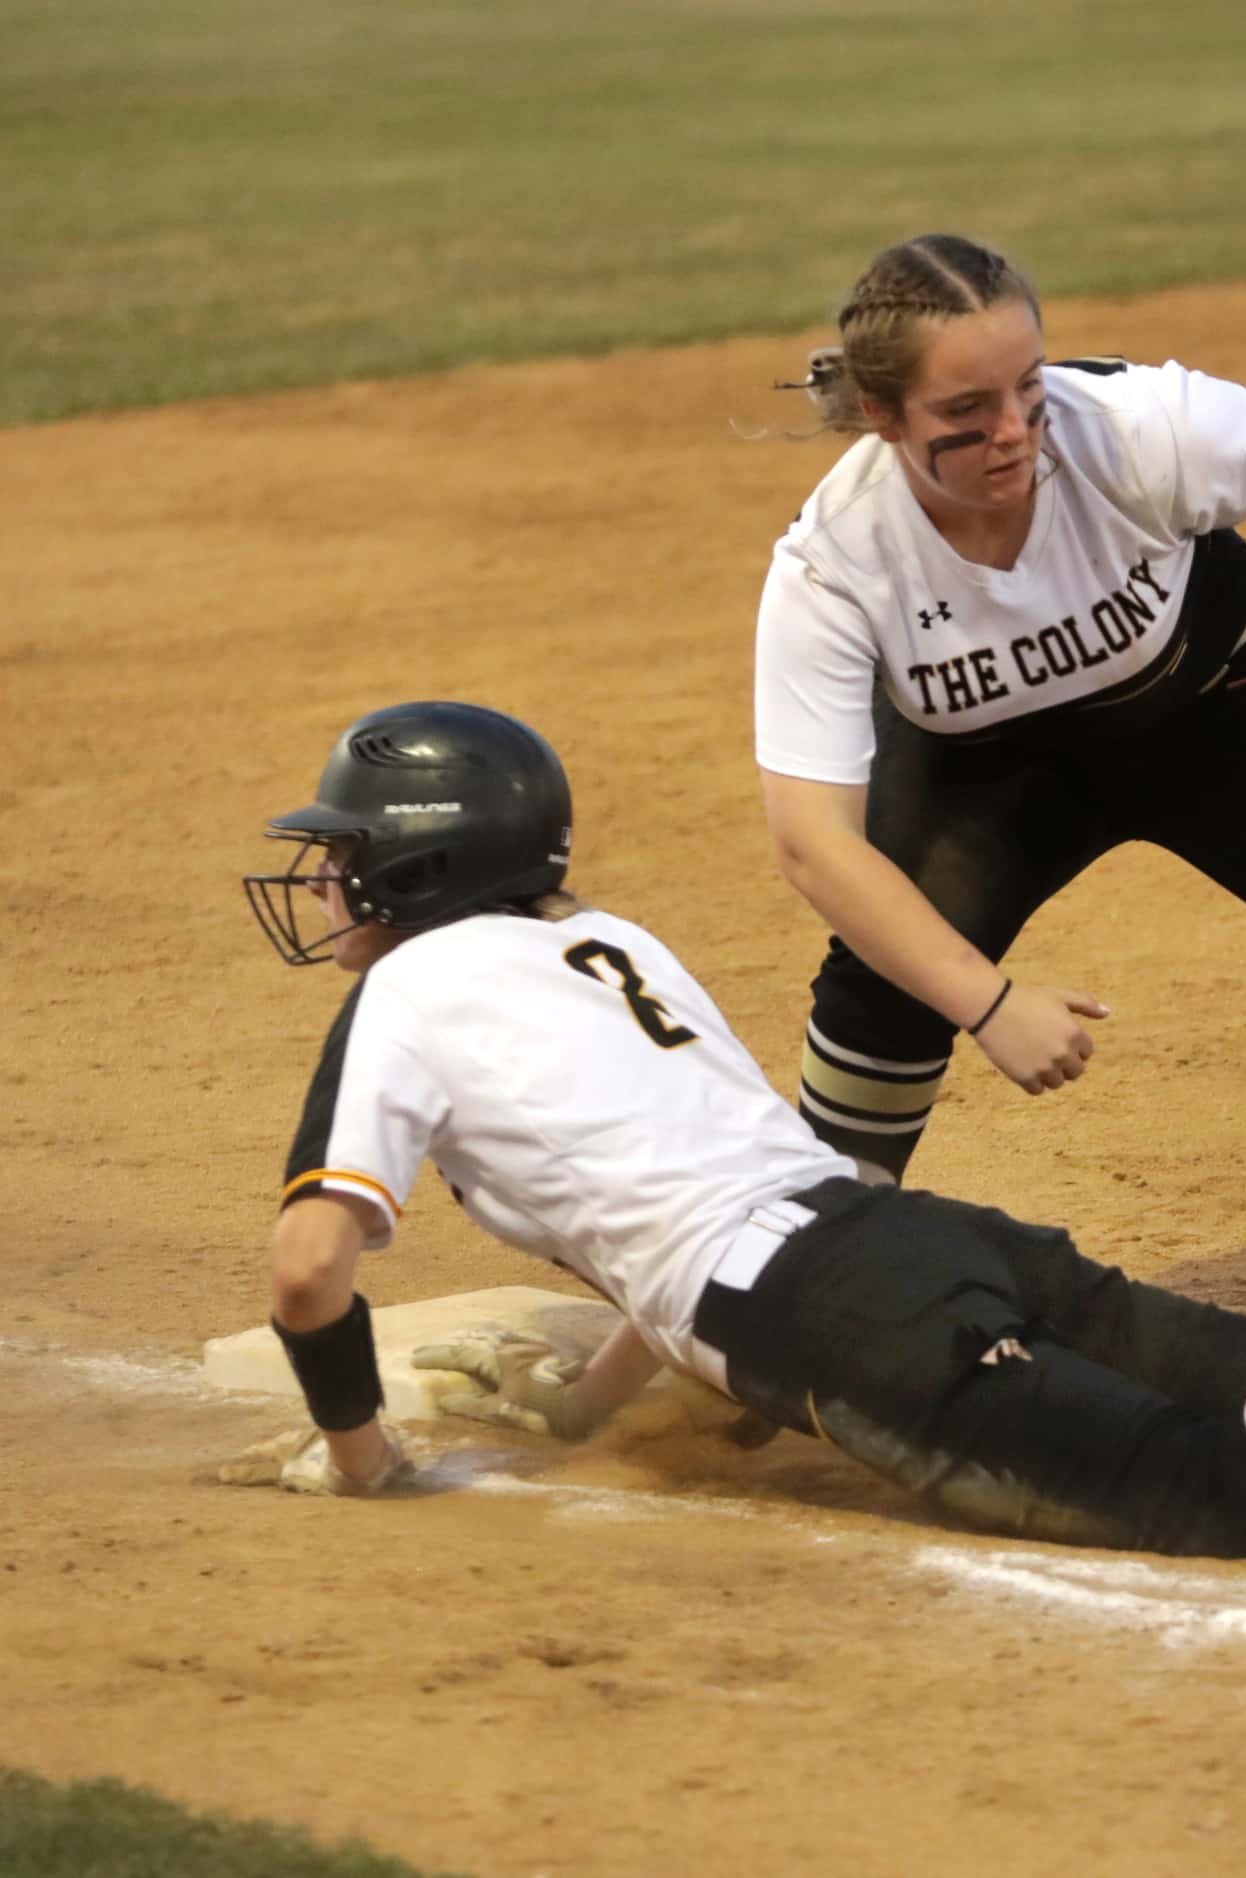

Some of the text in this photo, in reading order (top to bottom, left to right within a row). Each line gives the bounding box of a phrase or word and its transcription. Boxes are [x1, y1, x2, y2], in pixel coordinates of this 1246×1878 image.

[908, 558, 1170, 715] THE COLONY
[563, 938, 701, 1050] 2
